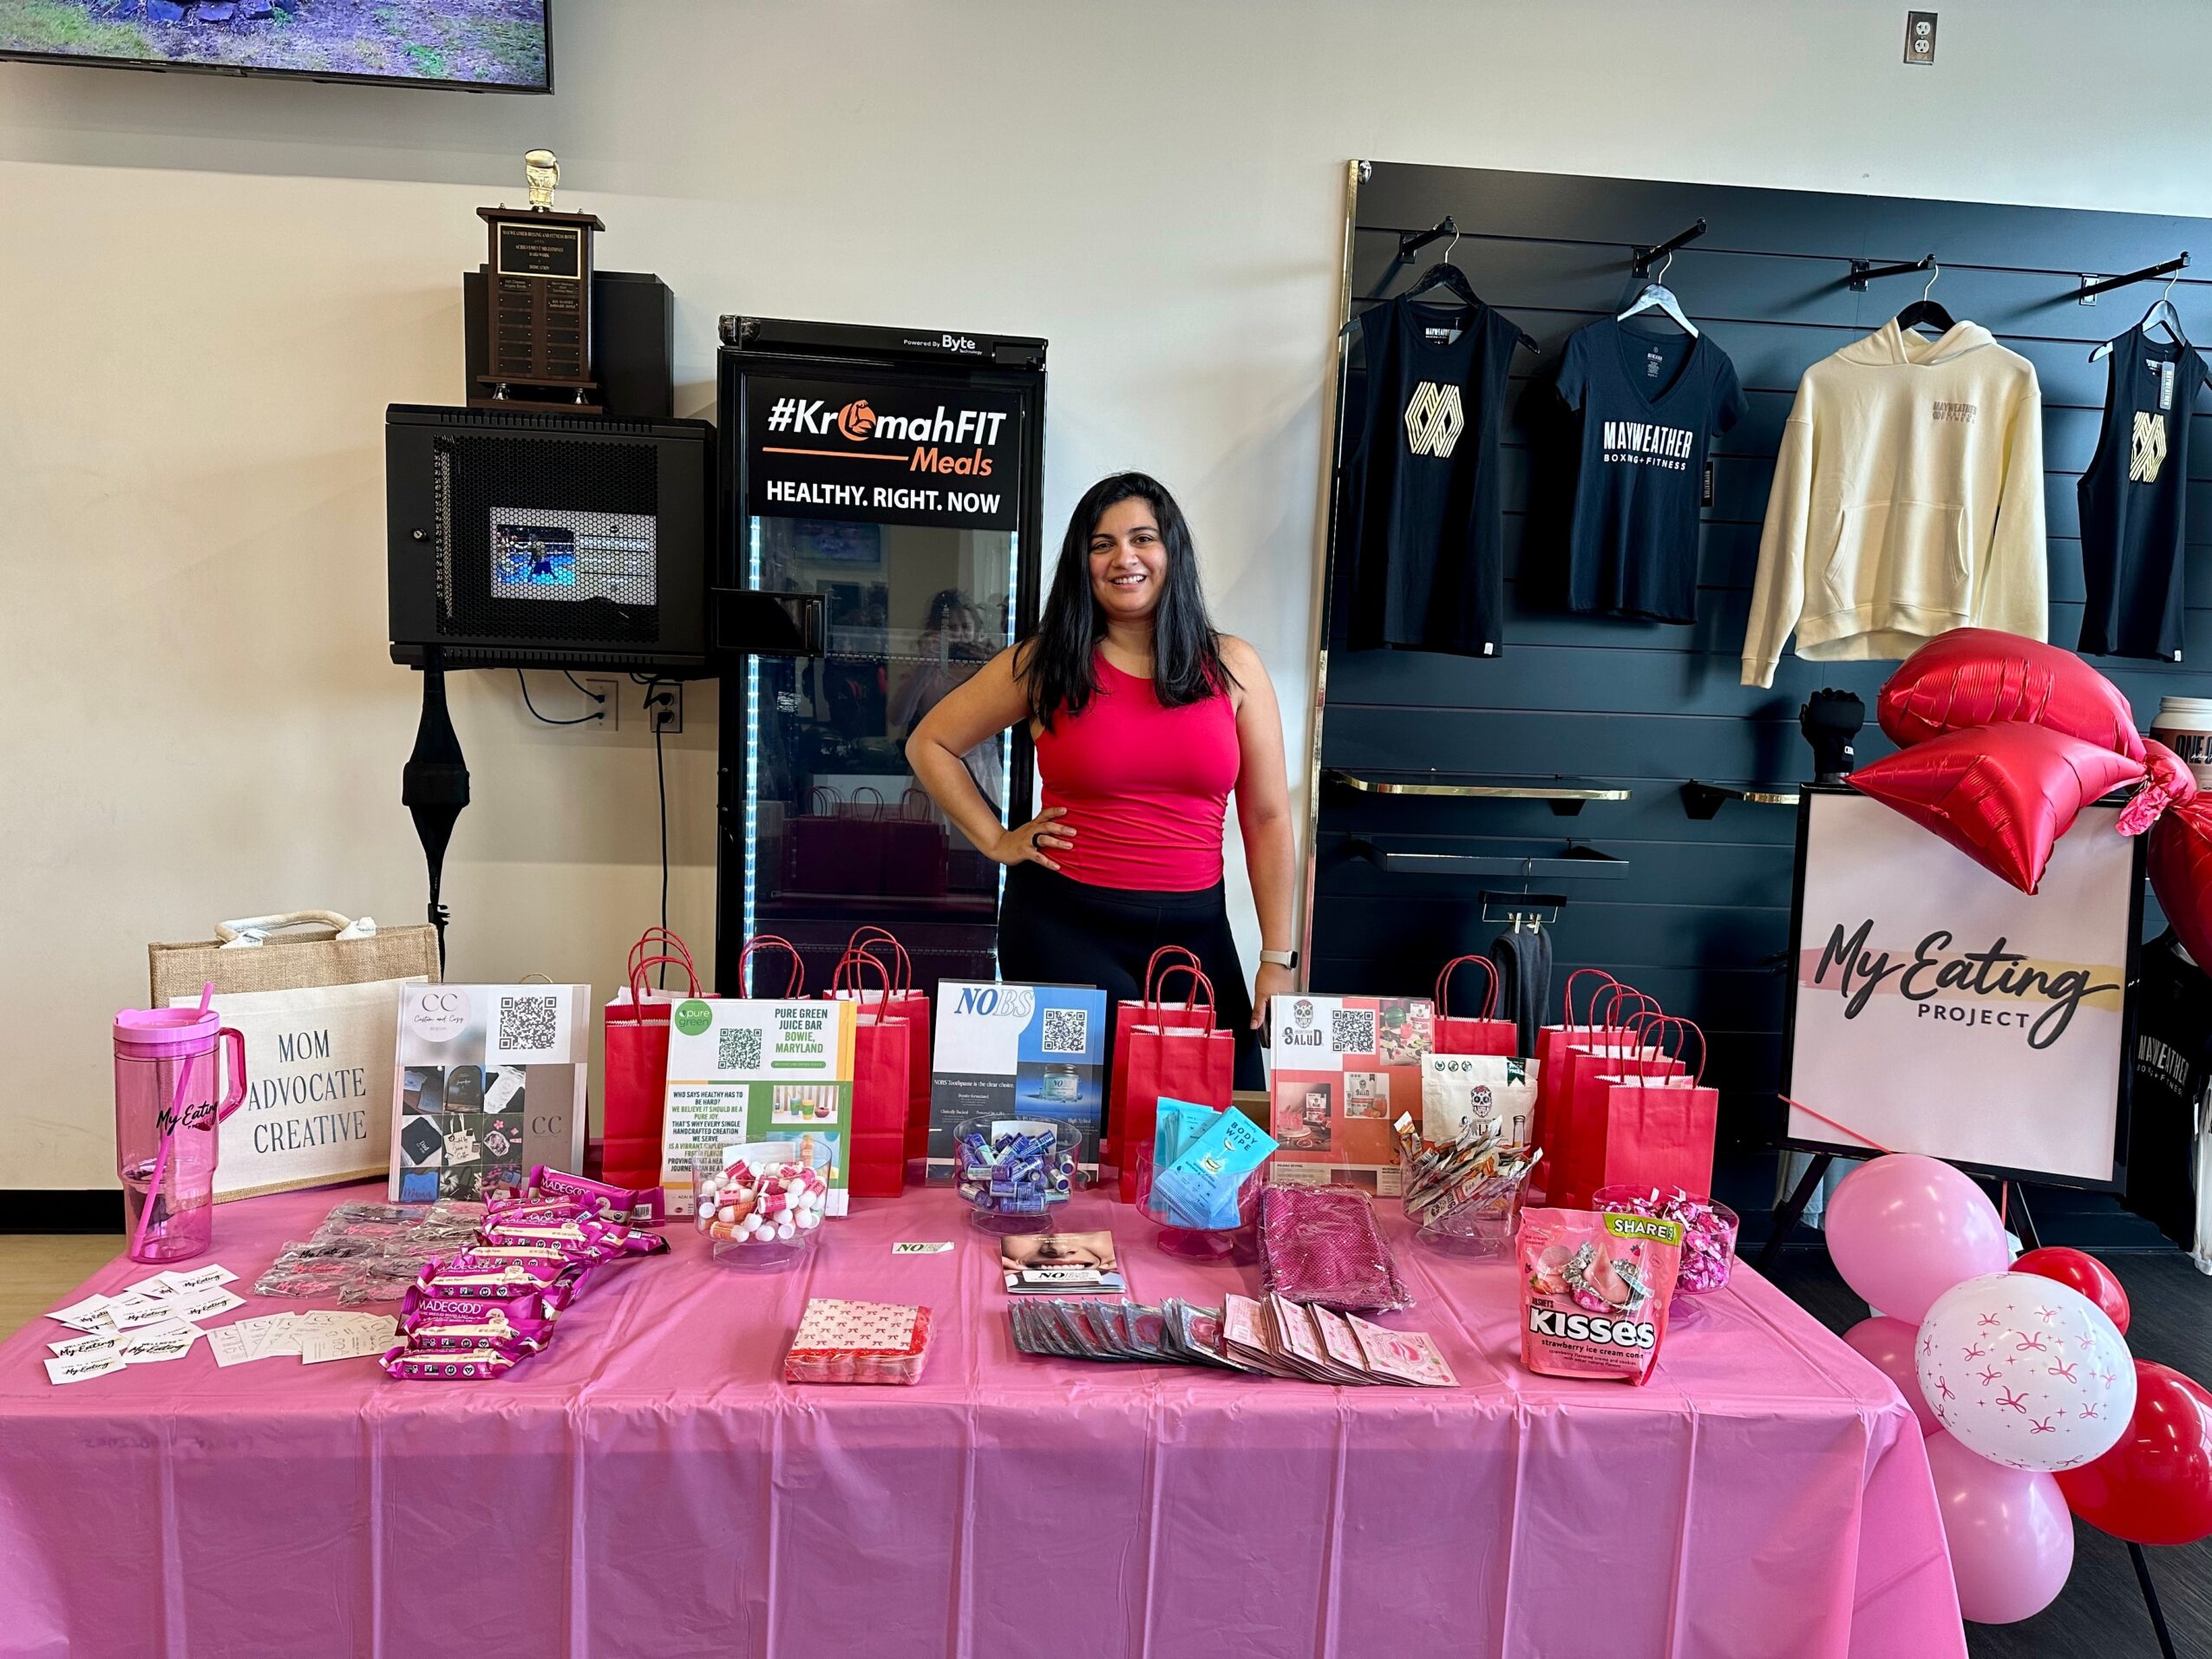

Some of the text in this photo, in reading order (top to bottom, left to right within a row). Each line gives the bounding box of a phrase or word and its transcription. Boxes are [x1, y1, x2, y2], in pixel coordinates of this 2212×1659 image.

[942, 334, 976, 351] Byte
[1604, 421, 1693, 459] MAYWEATHER
[910, 447, 993, 476] Meals
[767, 480, 1000, 514] HEALTHY. RIGHT. NOW
[1815, 918, 2120, 1050] My Eating
[422, 993, 458, 1012] CC
[954, 987, 1036, 1018] NOBS
[679, 1018, 709, 1028] green
[687, 1009, 710, 1018] pure
[775, 1009, 828, 1019] PURE GREEN
[1918, 1003, 2029, 1029] PROJECT
[779, 1020, 821, 1029] JUICE BAR
[278, 1029, 330, 1063] MOM
[785, 1031, 815, 1042] BOWIE,
[776, 1043, 823, 1053] MARYLAND
[248, 1068, 366, 1111] ADVOCATE
[156, 1109, 183, 1136] My
[254, 1111, 367, 1153] CREATIVE
[1226, 1128, 1251, 1151] WIPE
[1231, 1121, 1258, 1145] BODY
[420, 1140, 429, 1152] Dad
[1614, 1218, 1667, 1238] SHARE
[298, 1249, 315, 1258] My
[60, 1339, 115, 1357] My Eating
[128, 1343, 187, 1356] My Eating
[1541, 1338, 1584, 1352] strawberry
[65, 1367, 78, 1375] My
[80, 1361, 111, 1373] Eating
